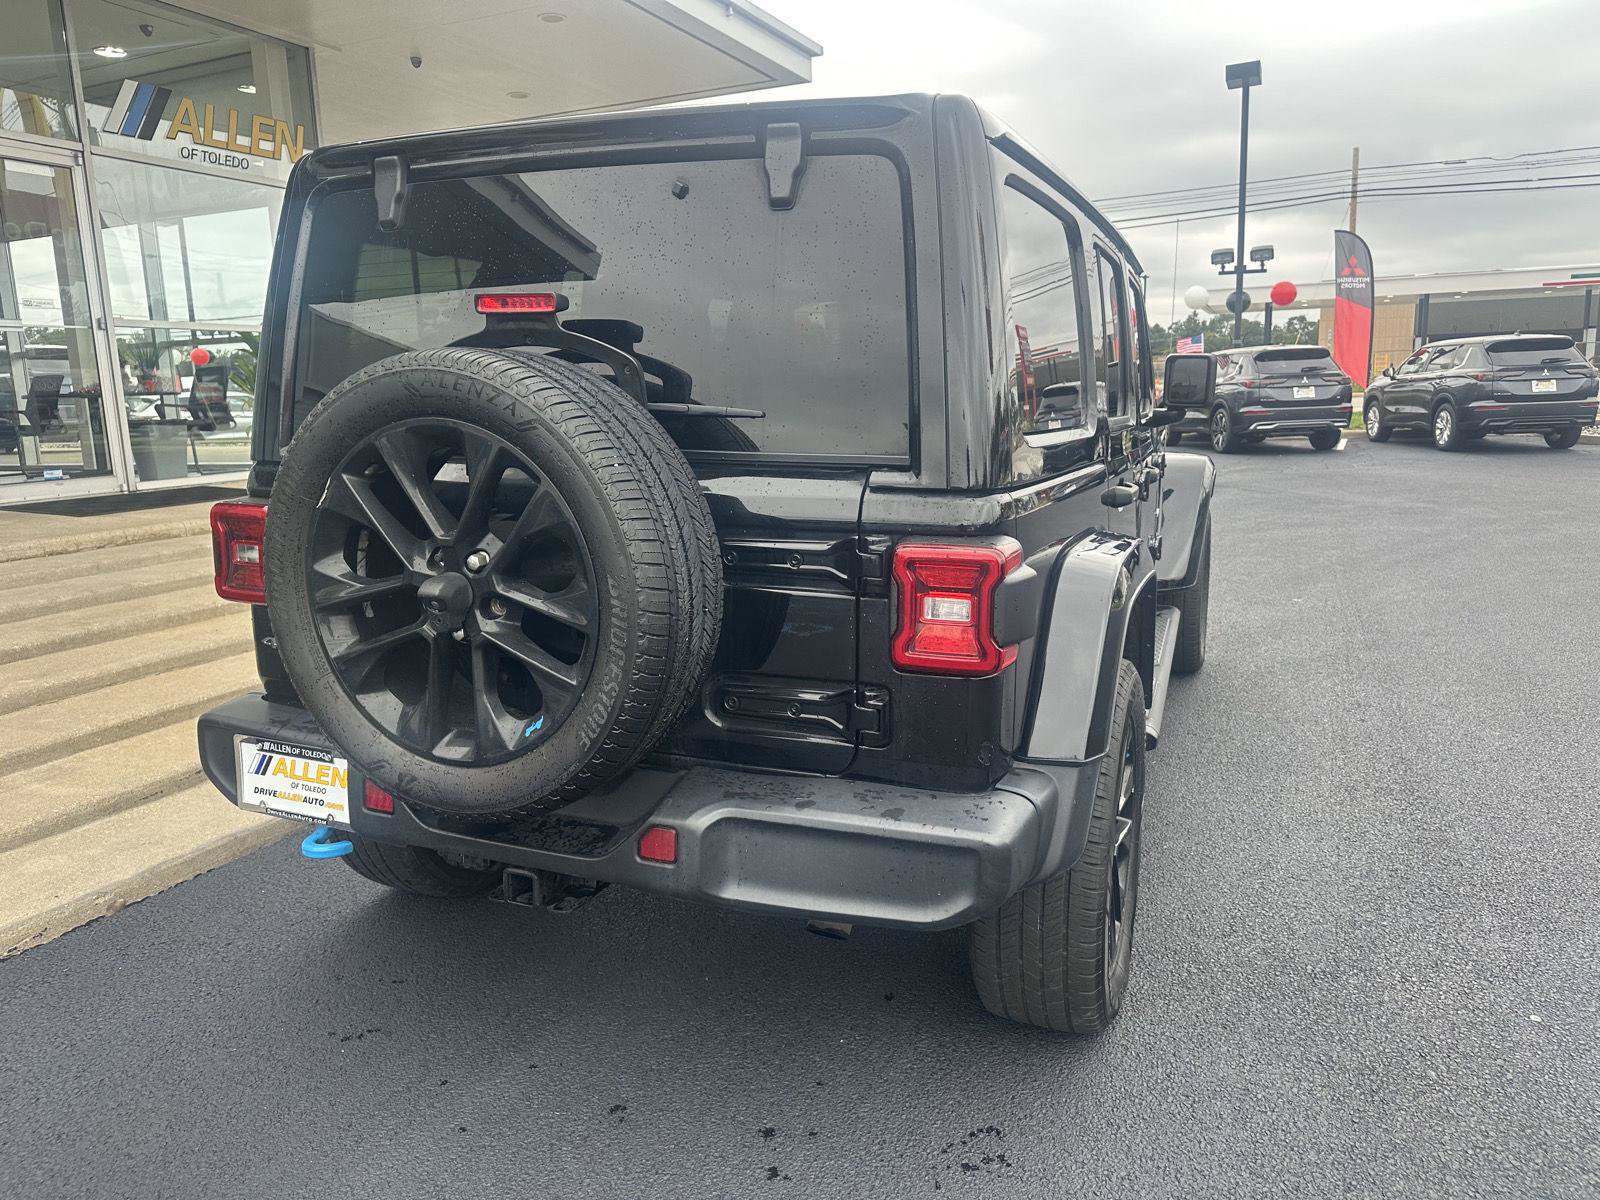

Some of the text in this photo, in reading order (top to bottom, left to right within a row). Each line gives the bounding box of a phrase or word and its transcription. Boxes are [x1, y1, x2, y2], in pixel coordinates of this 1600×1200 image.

[166, 96, 304, 163] ALLEN
[180, 146, 250, 170] OF TOLEDO
[420, 376, 516, 418] ALENZA
[579, 574, 628, 751] BRIDGESTONE
[270, 742, 326, 760] ALLEN OF TOLEDO
[272, 757, 348, 789] ALLEN
[290, 782, 327, 795] OF TOLEDO
